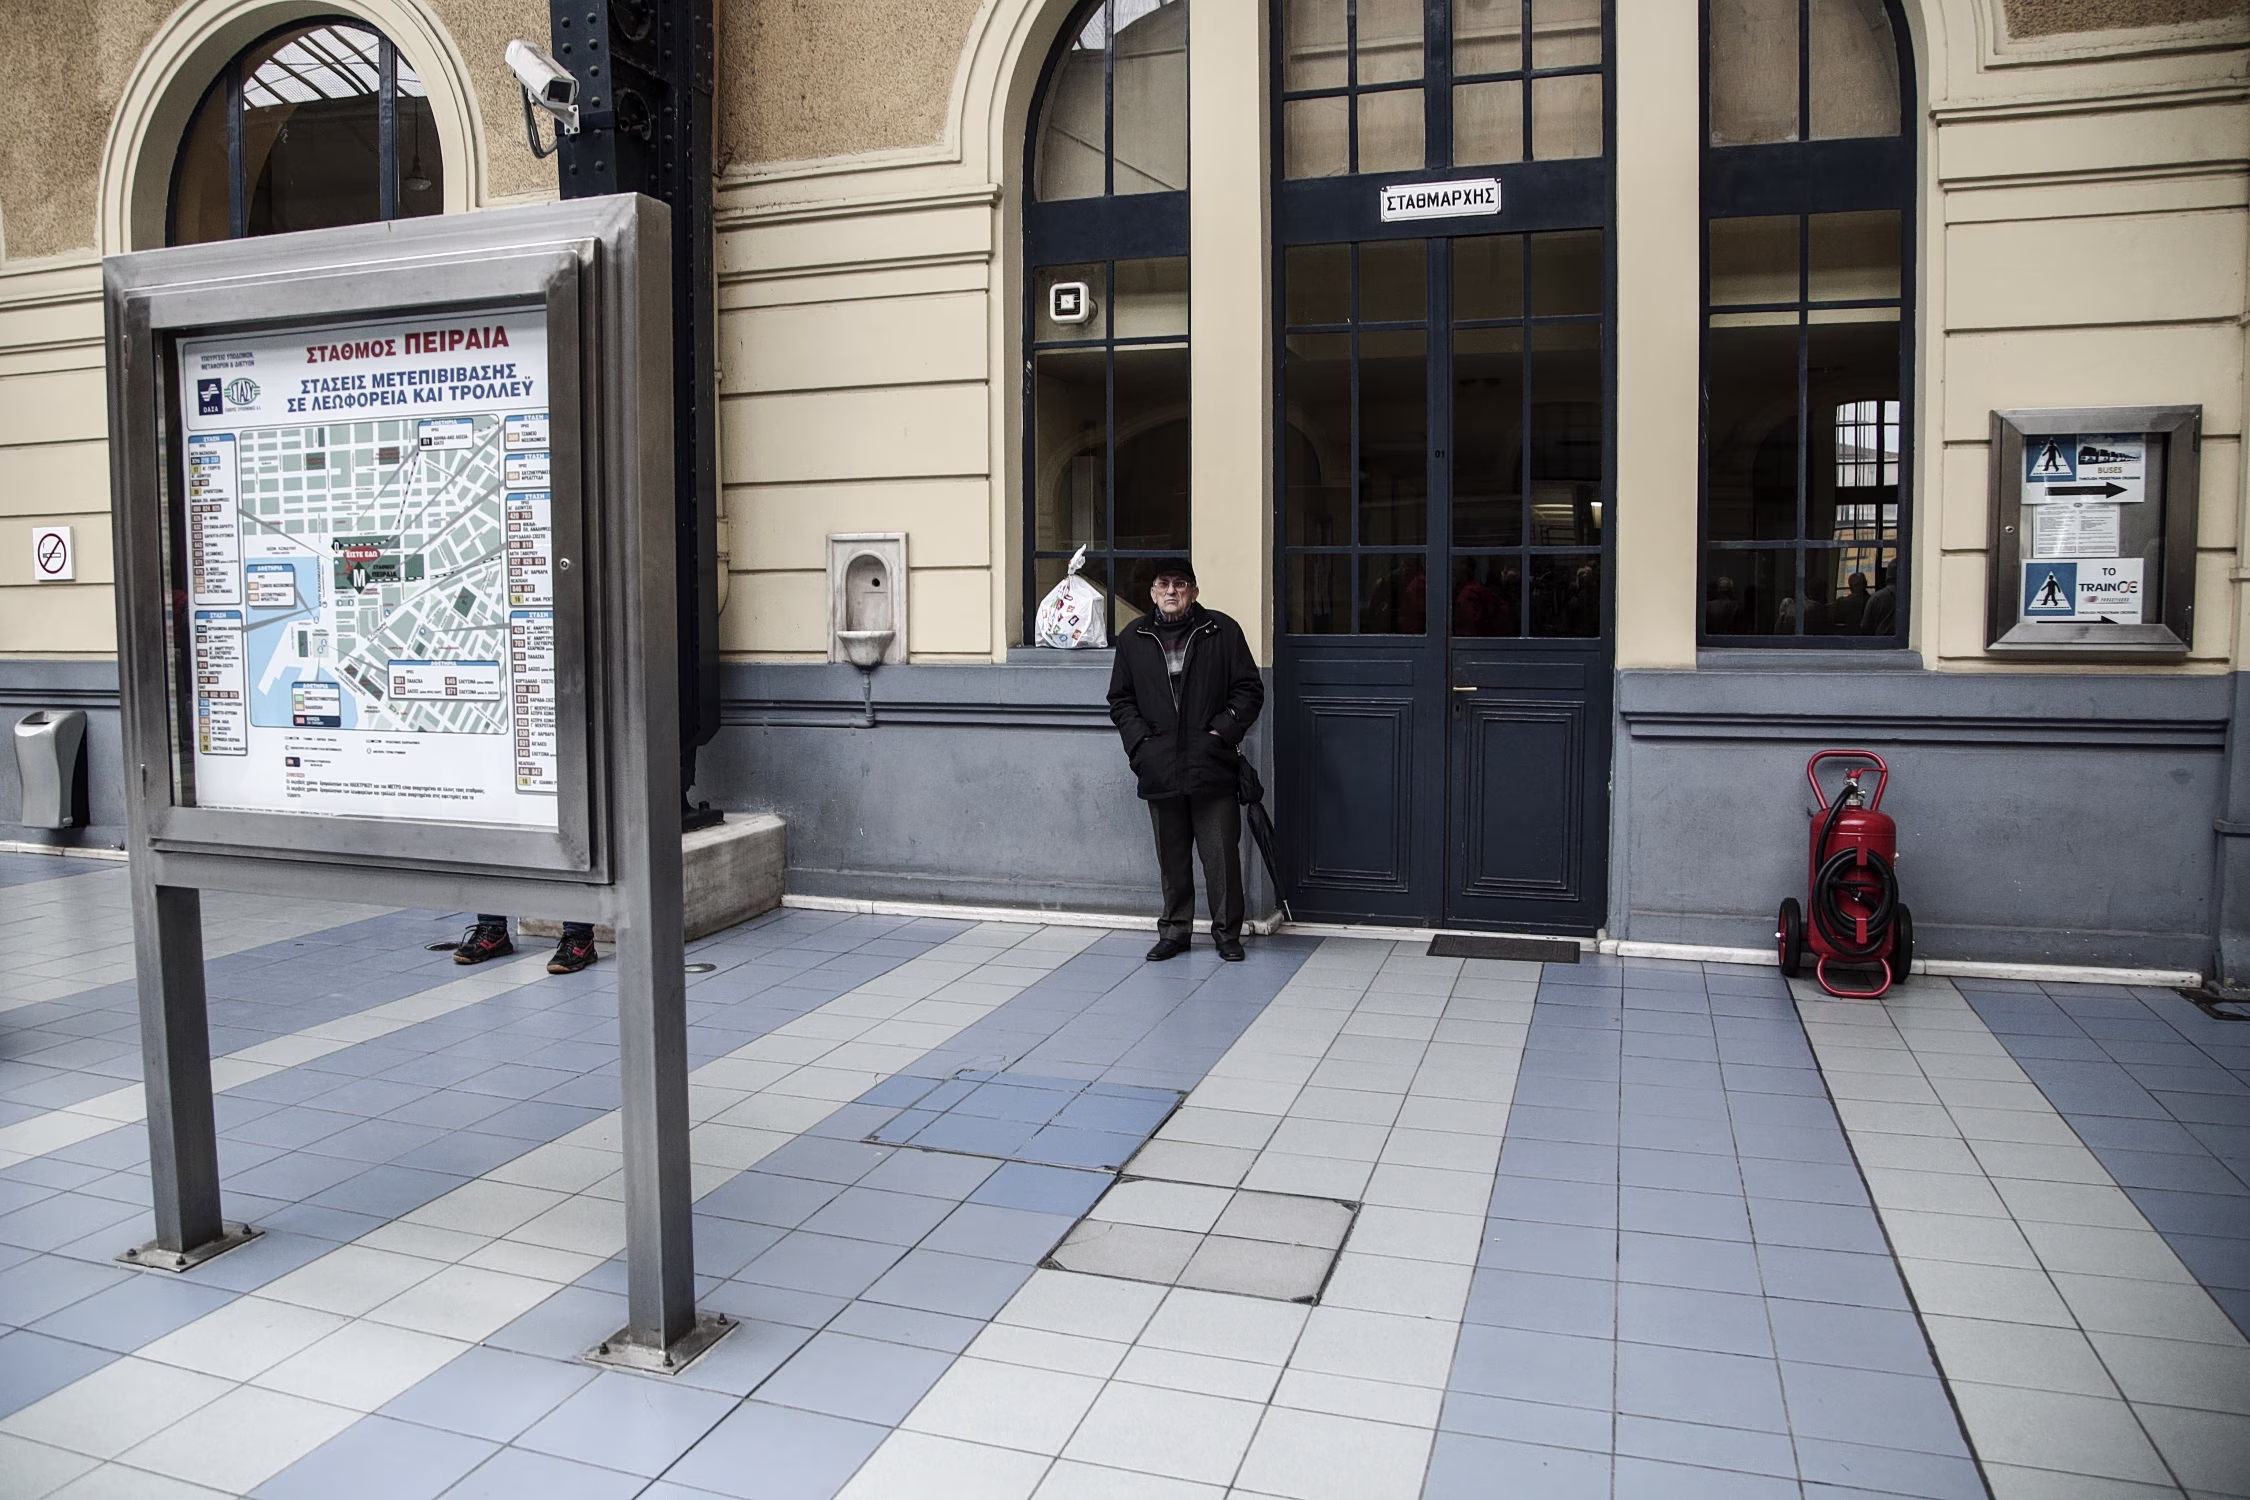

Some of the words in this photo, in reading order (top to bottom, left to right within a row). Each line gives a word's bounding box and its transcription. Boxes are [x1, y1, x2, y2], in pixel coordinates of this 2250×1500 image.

[1387, 187, 1495, 211] ΣΤΑΘΜΑΡΧΗΣ
[306, 339, 396, 363] ΣΤΑΘΜΟΣ
[405, 326, 509, 355] ΠΕΙΡΑΙΑ
[301, 375, 366, 395] ΣΤΑΣΕΙΣ
[372, 363, 516, 389] ΜΕΤΕΠΙΒΙΒΑΣΗΣ
[231, 381, 254, 402] ΣΤΑΣΥ
[287, 397, 306, 413] ΣΕ
[312, 389, 407, 411] ΛΕΩΦΟΡΕΙΑ
[413, 387, 442, 404] ΚΑΙ
[449, 376, 534, 401] ΤΡΟΛΛΕΫ
[1435, 450, 1445, 459] 01
[2097, 466, 2122, 474] BUSES
[2102, 568, 2116, 576] TO
